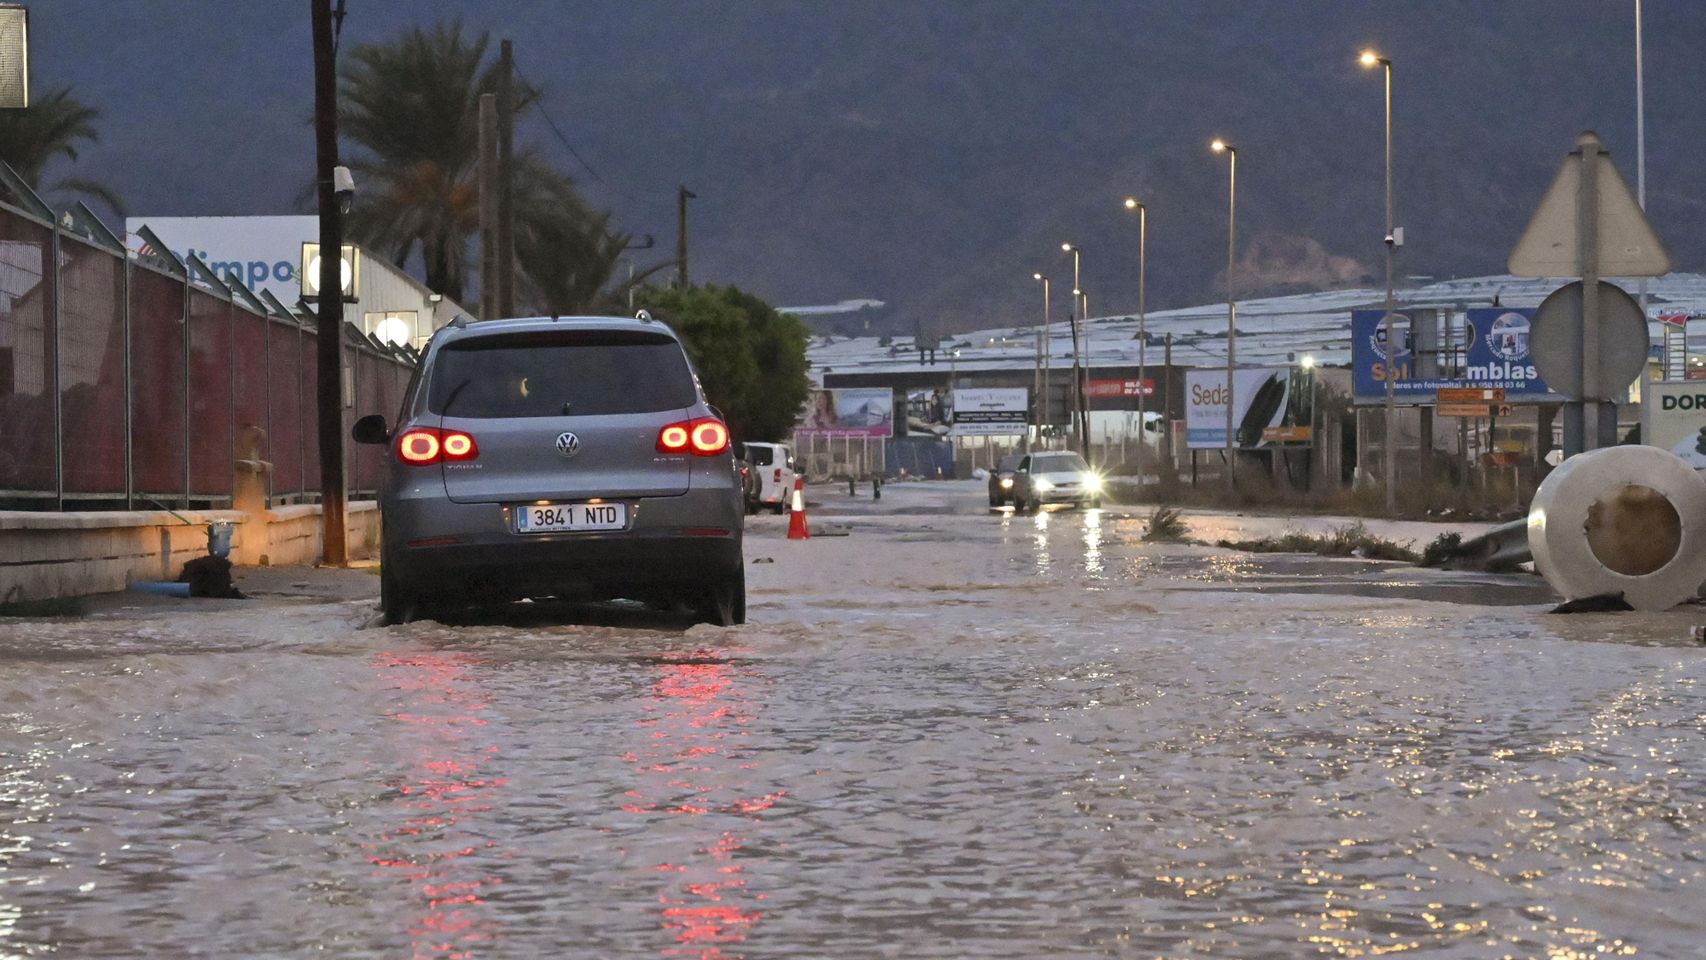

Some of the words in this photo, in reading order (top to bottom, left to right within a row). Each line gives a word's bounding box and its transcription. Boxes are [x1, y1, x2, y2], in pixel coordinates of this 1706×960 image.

[171, 248, 294, 291] limpo
[1191, 383, 1230, 406] Seda
[534, 508, 573, 526] 3841
[585, 506, 617, 524] NTD
